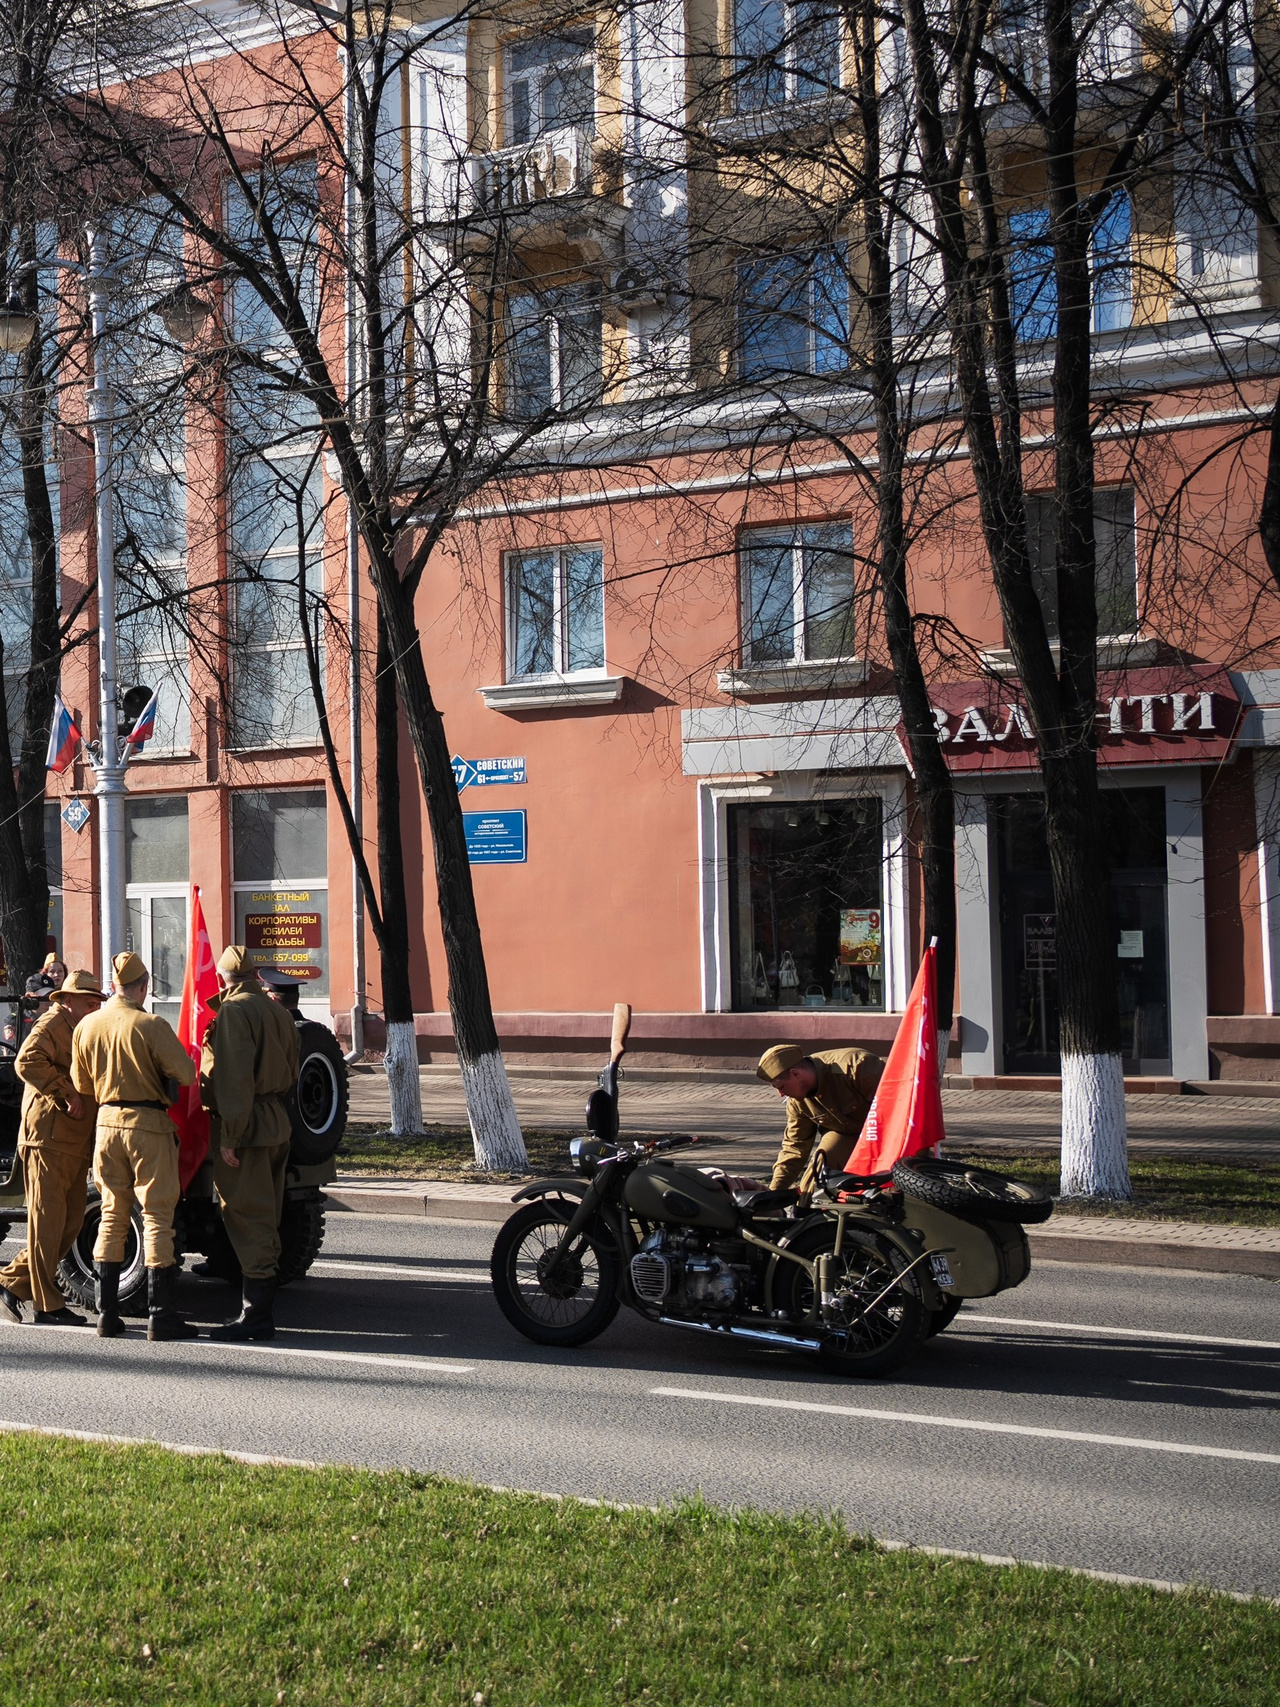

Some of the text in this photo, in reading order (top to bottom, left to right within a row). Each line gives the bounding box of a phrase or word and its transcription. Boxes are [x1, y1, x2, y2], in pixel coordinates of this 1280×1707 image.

[477, 774, 485, 783] 61
[514, 772, 523, 781] 57
[252, 892, 310, 901] БАНКЕТНЫЙ
[272, 904, 290, 912] ЗАЛ
[249, 916, 317, 925] КОРПОРАТИВЫ
[869, 912, 880, 929] 9
[263, 927, 302, 935] ЮБИЛЕИ
[1027, 927, 1056, 935] ВАЛЕН
[260, 938, 305, 946] СВАДЬБЫ
[1030, 941, 1056, 953] 10-2
[273, 954, 309, 962] 657-099
